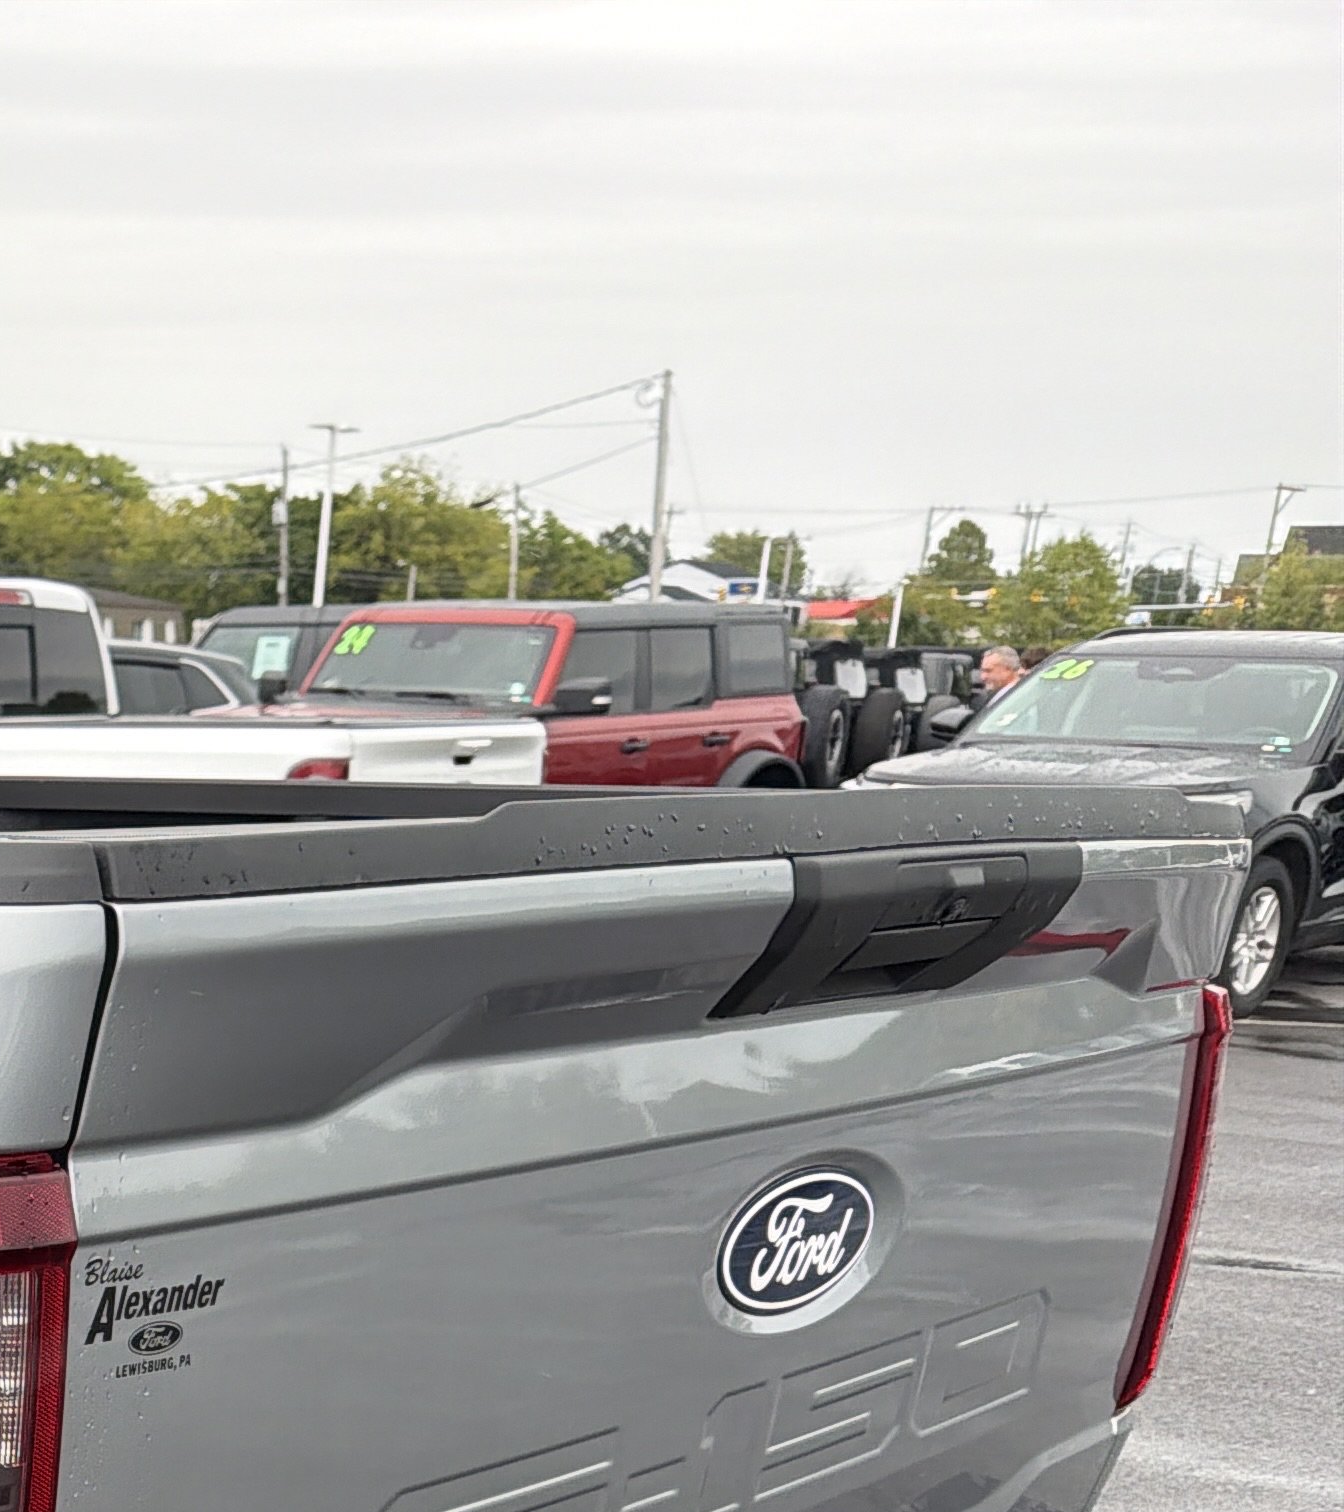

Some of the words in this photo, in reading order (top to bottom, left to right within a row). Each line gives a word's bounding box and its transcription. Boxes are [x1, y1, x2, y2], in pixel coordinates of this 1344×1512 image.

[748, 1192, 855, 1292] Ford
[84, 1257, 144, 1287] Blaise
[84, 1274, 226, 1346] Alexander
[115, 1357, 178, 1379] LEWISBURG,
[178, 1354, 192, 1368] PA
